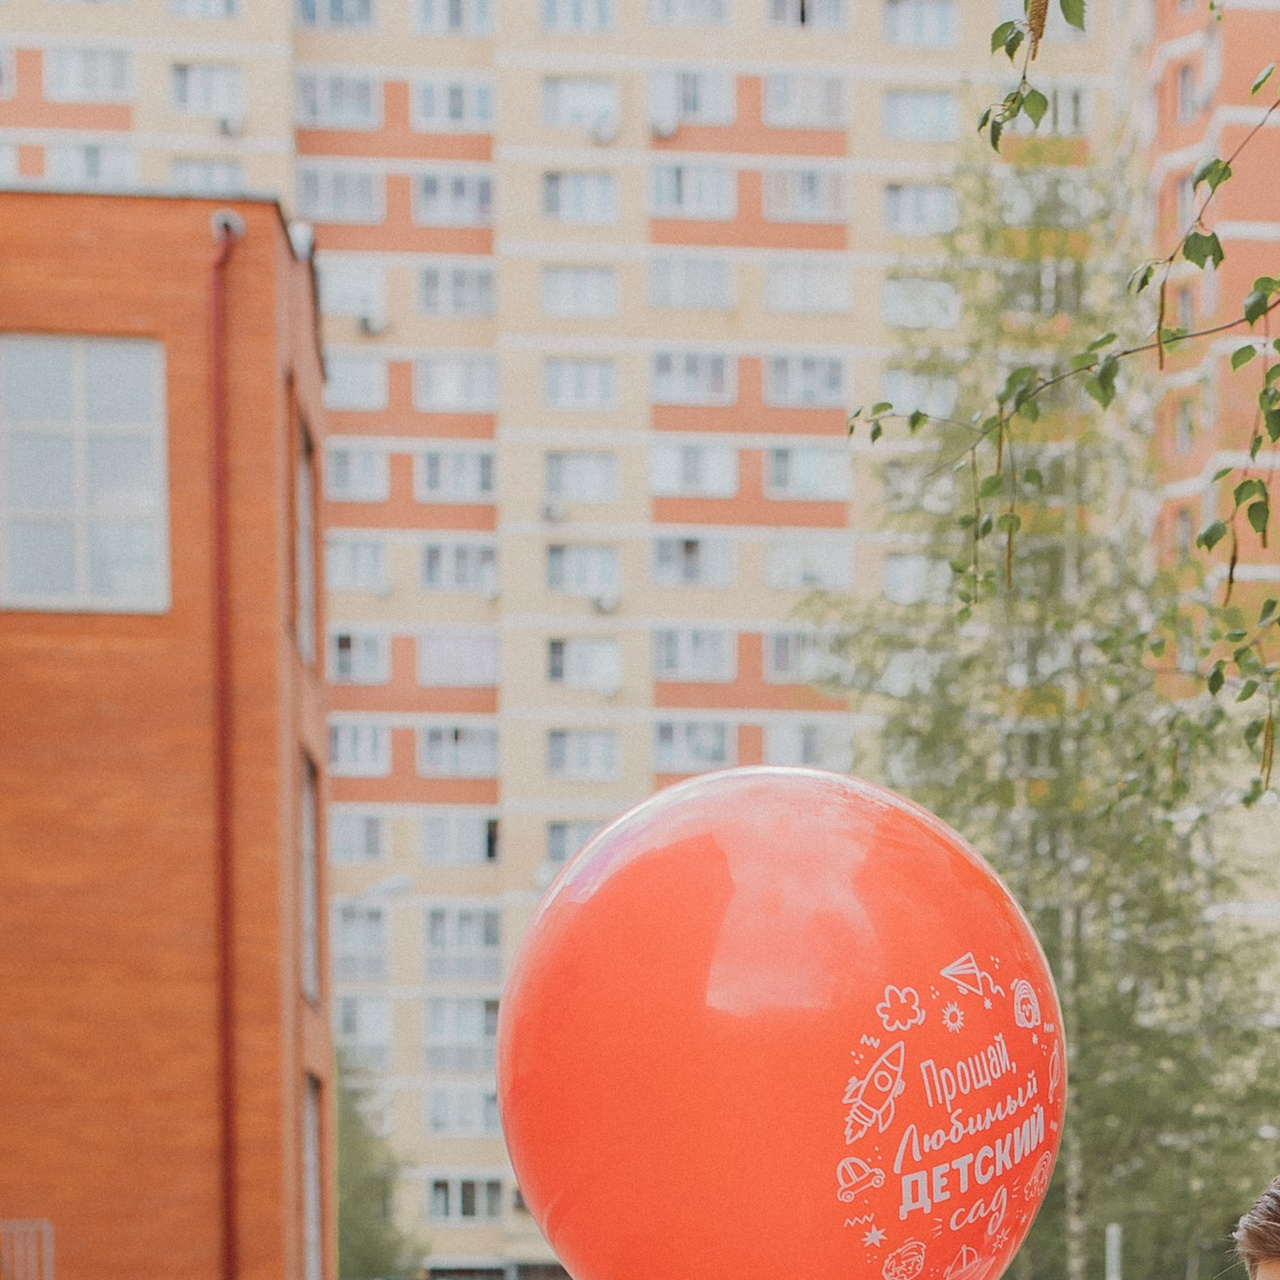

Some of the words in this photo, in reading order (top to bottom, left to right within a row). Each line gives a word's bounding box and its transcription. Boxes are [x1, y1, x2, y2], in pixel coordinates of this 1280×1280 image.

[920, 1033, 1017, 1113] Прощай,
[894, 1071, 1038, 1174] Любимый
[900, 1106, 1045, 1220] ДЕТСКИЙ
[949, 1185, 1008, 1235] сад
